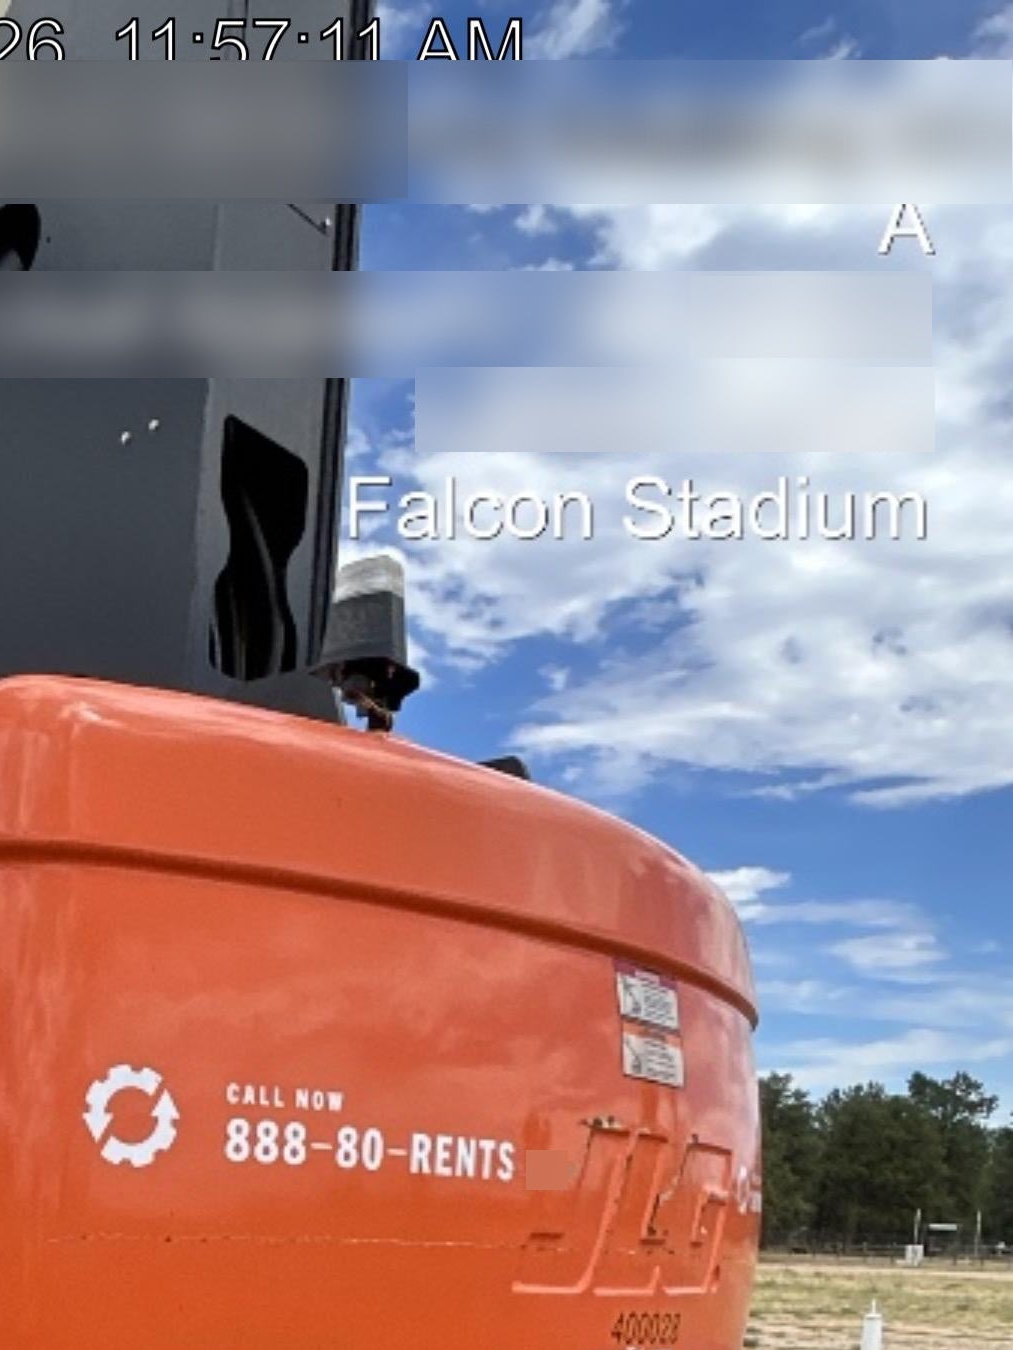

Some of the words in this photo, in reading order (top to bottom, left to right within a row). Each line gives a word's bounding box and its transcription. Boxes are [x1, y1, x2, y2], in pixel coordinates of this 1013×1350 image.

[226, 1082, 285, 1108] CALL
[294, 1087, 345, 1112] NOW
[224, 1117, 516, 1181] 888-80-RENTS
